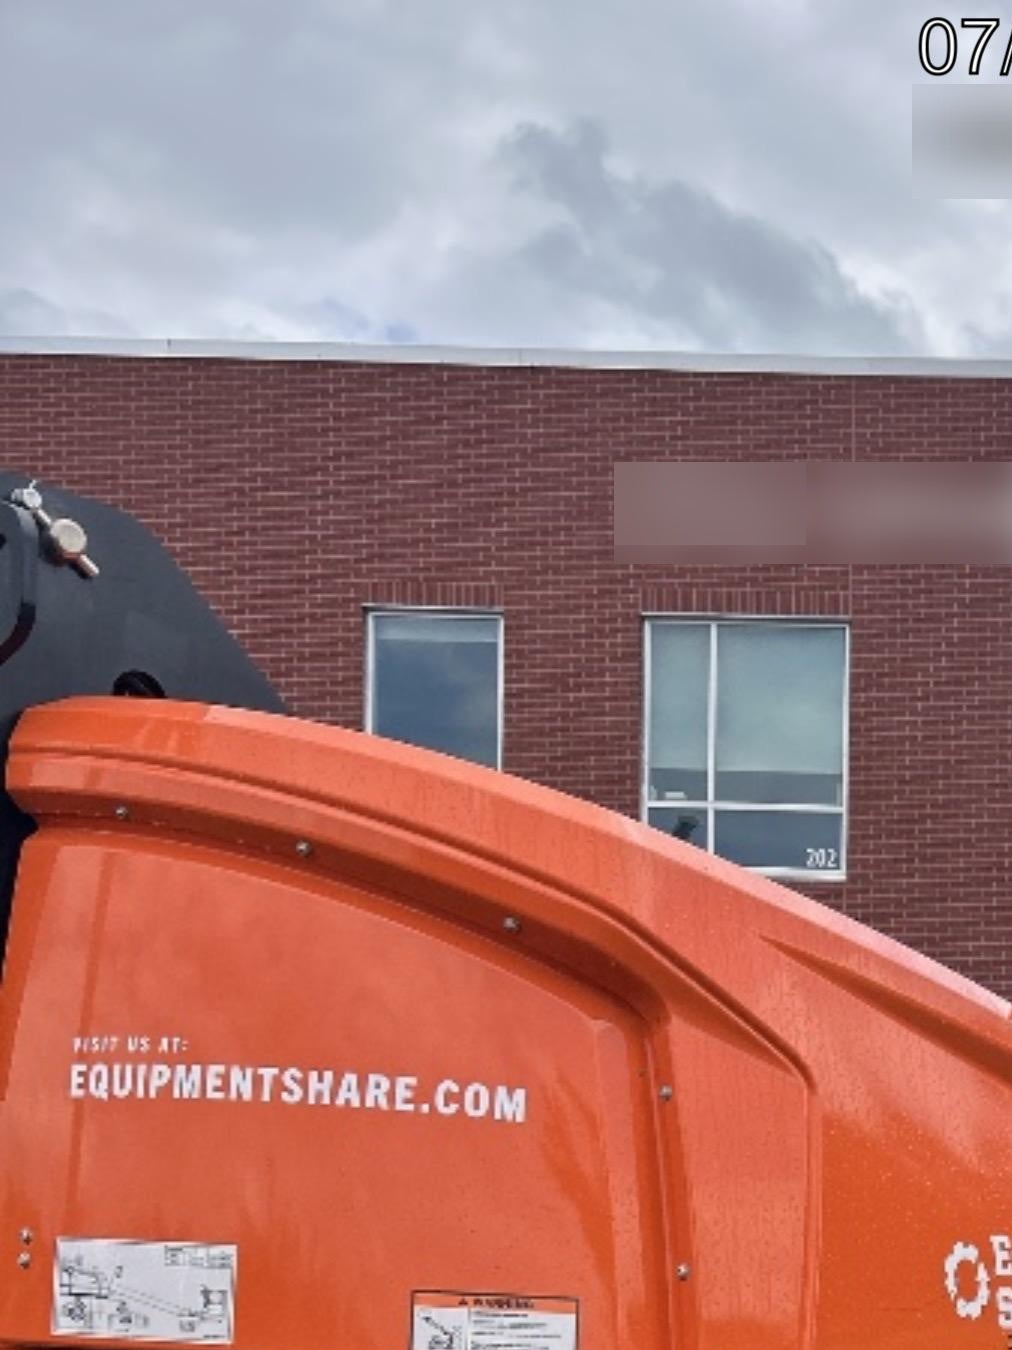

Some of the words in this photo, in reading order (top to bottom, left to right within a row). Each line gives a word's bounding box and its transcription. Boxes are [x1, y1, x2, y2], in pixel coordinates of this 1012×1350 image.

[806, 848, 838, 868] 202
[127, 1034, 151, 1054] US
[157, 1035, 190, 1054] AT:
[69, 1062, 527, 1123] EQUIPMENTSHARE.COM
